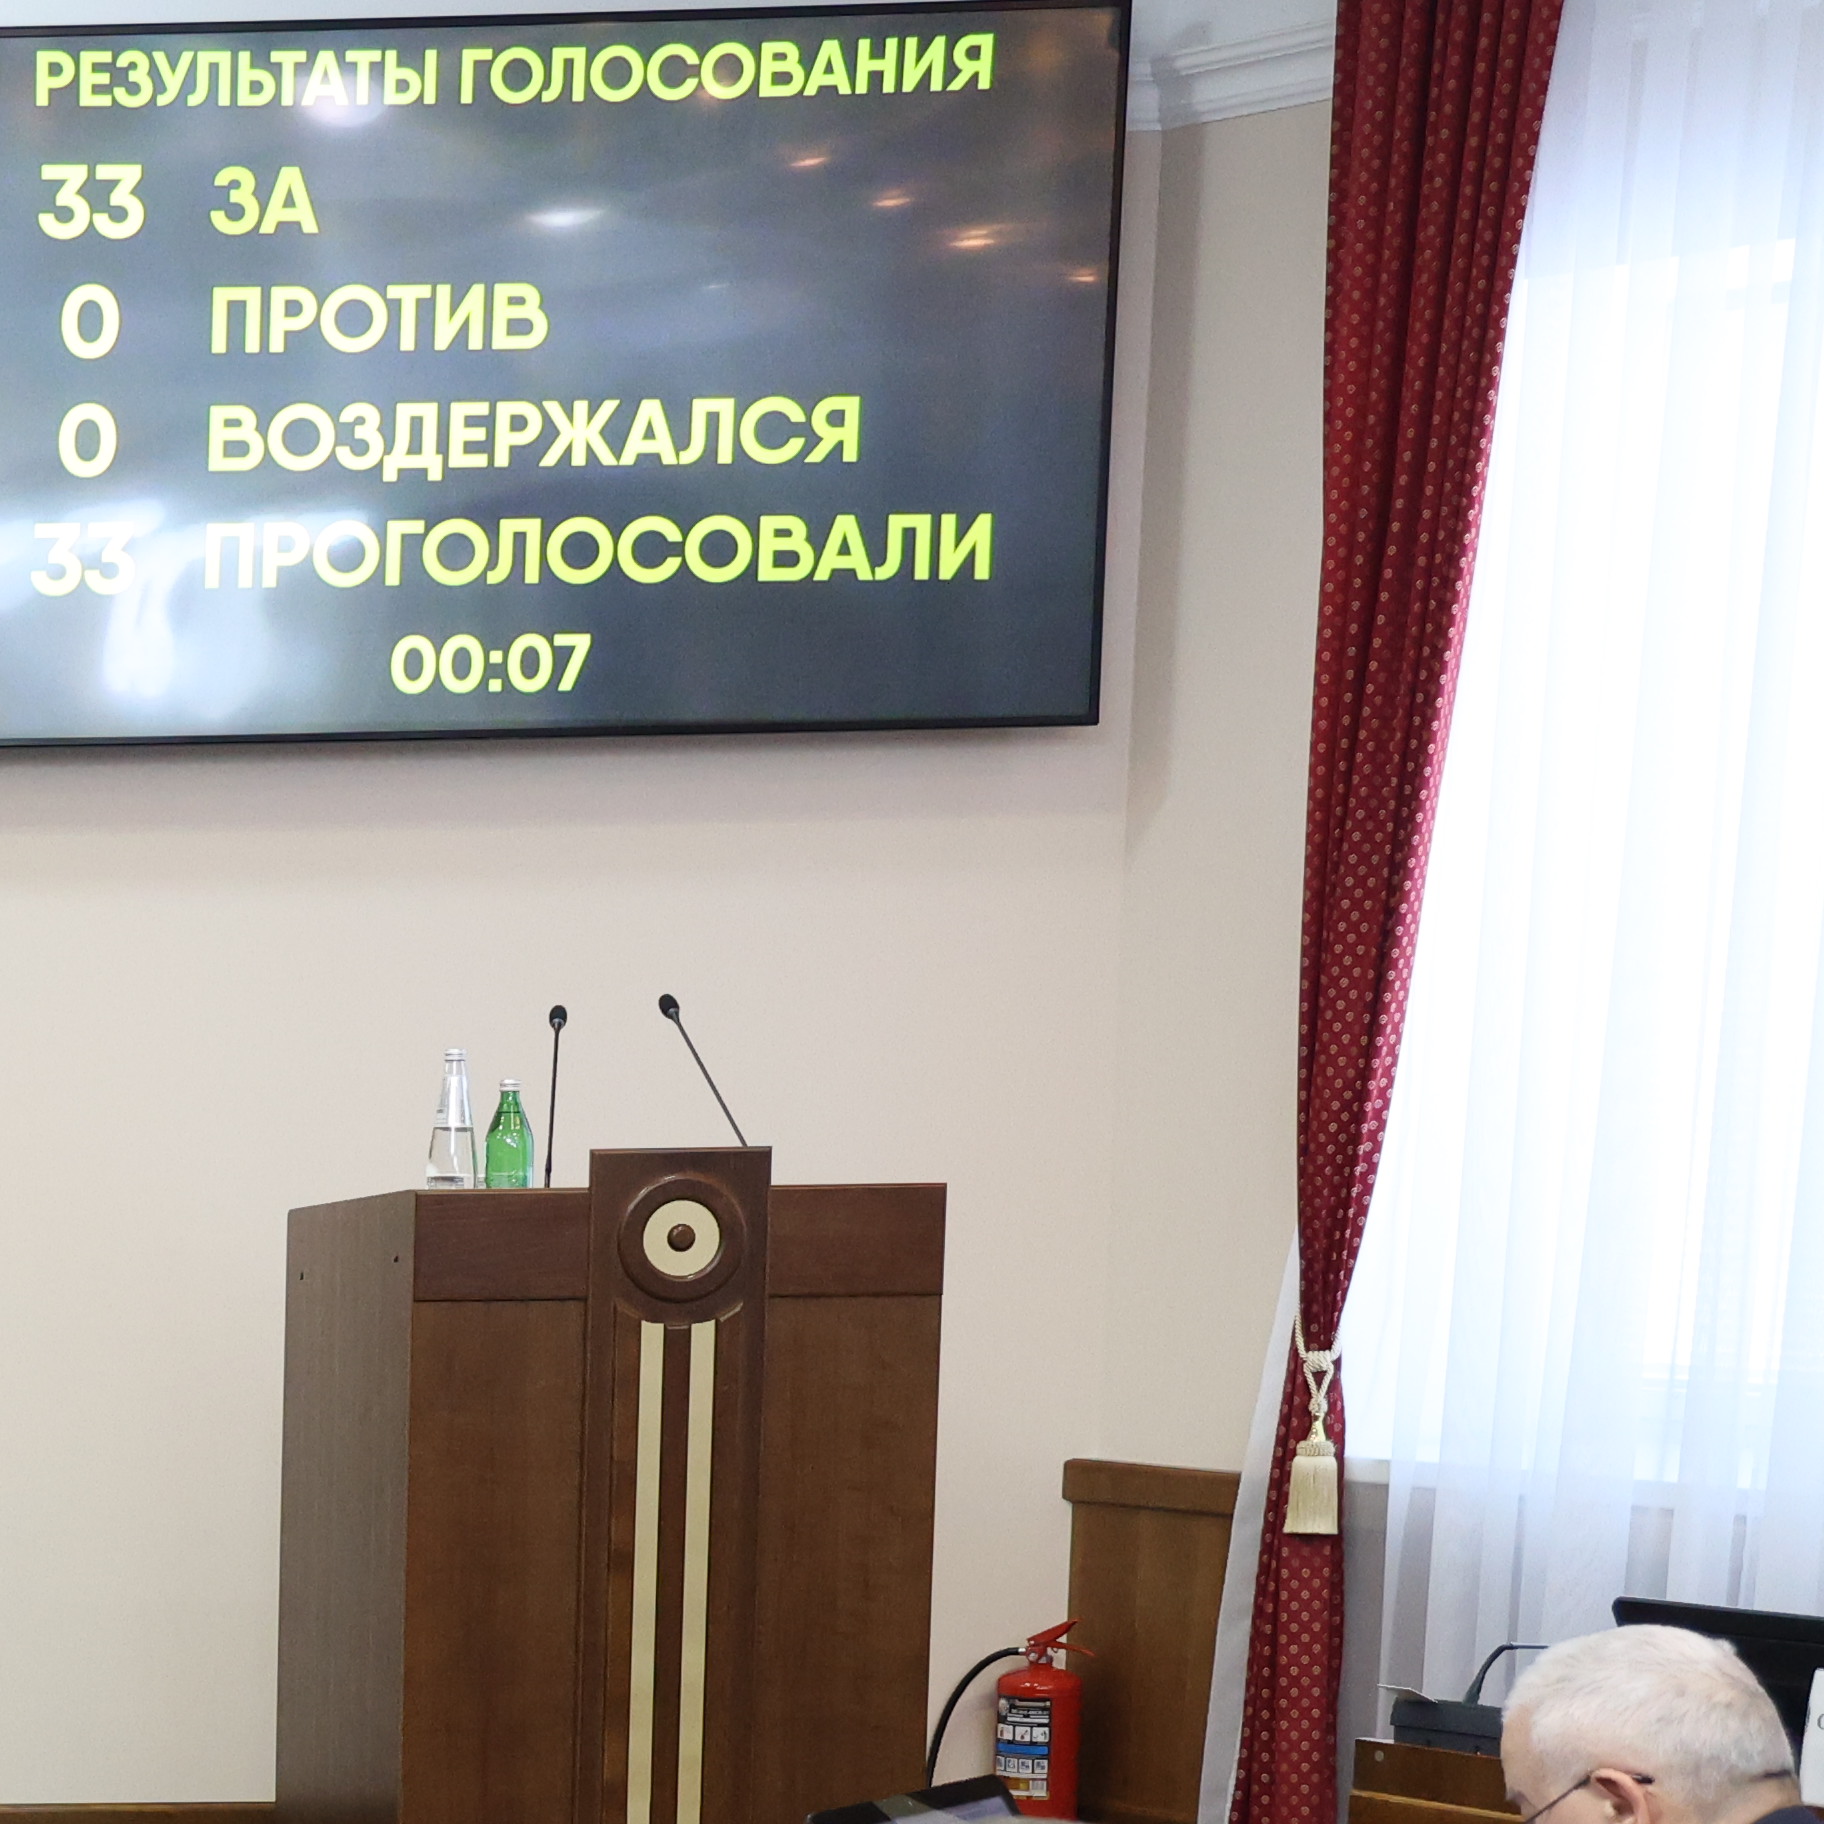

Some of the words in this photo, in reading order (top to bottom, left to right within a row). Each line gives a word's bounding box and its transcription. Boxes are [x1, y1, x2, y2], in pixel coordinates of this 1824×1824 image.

[33, 48, 439, 108] РЕЗУЛЬТАТЫ
[458, 33, 996, 105] ГОЛОСОВАНИЯ
[37, 163, 145, 239] 33
[209, 165, 320, 236] ЗА
[59, 285, 120, 359] 0
[209, 283, 550, 354] ПРОТИВ
[57, 403, 117, 477] 0
[207, 396, 861, 480] ВОЗДЕРЖАЛСЯ
[30, 522, 138, 597] 33
[202, 512, 994, 589] ПРОГОЛОСОВАЛИ
[389, 633, 593, 696] 00:07
